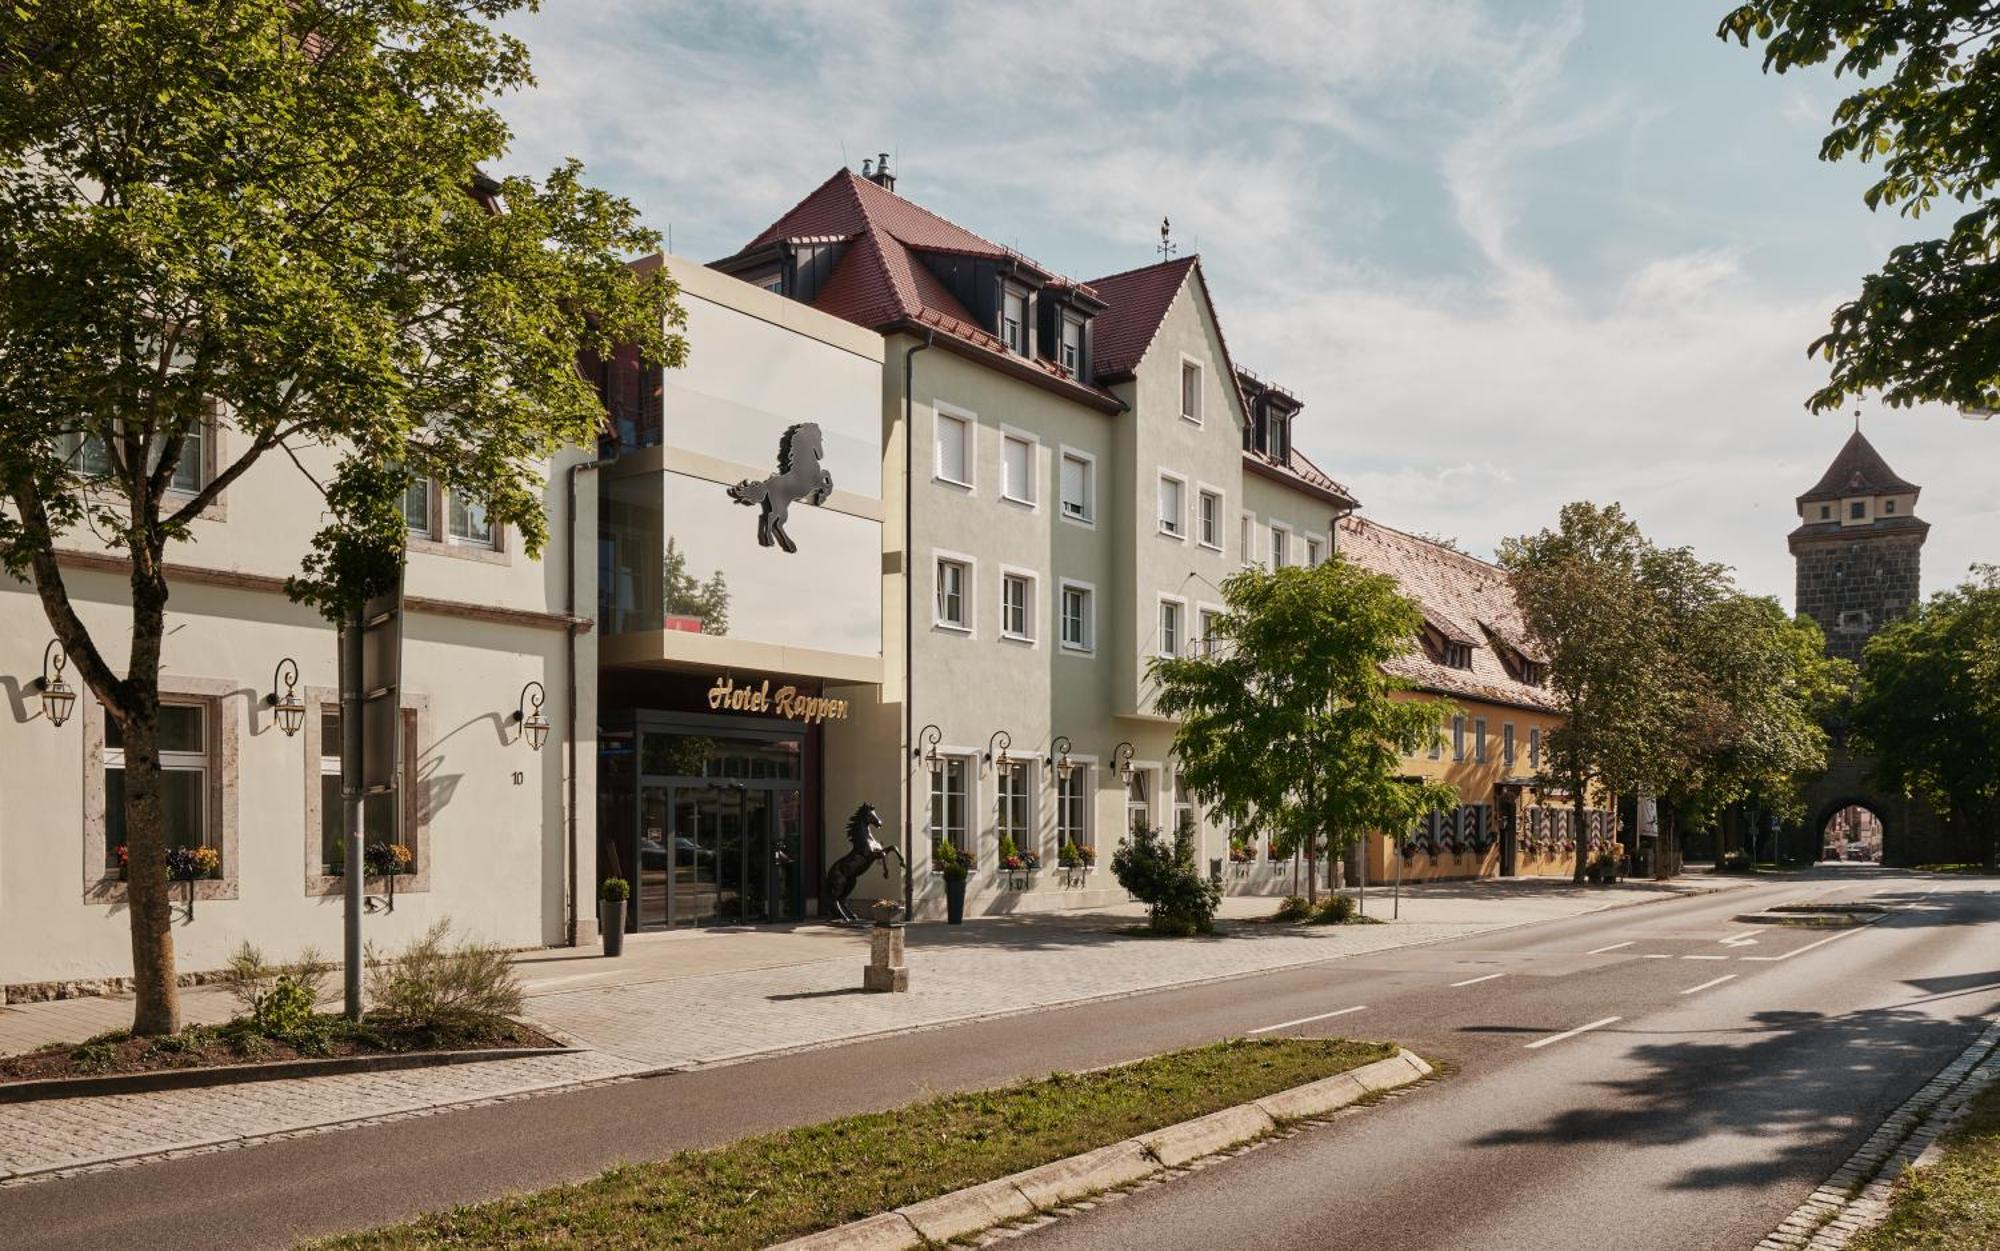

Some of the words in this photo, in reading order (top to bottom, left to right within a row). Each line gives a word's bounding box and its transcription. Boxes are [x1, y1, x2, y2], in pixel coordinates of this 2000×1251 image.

[708, 677, 769, 713] Hotel
[774, 685, 849, 724] Rappen
[511, 771, 523, 785] 10
